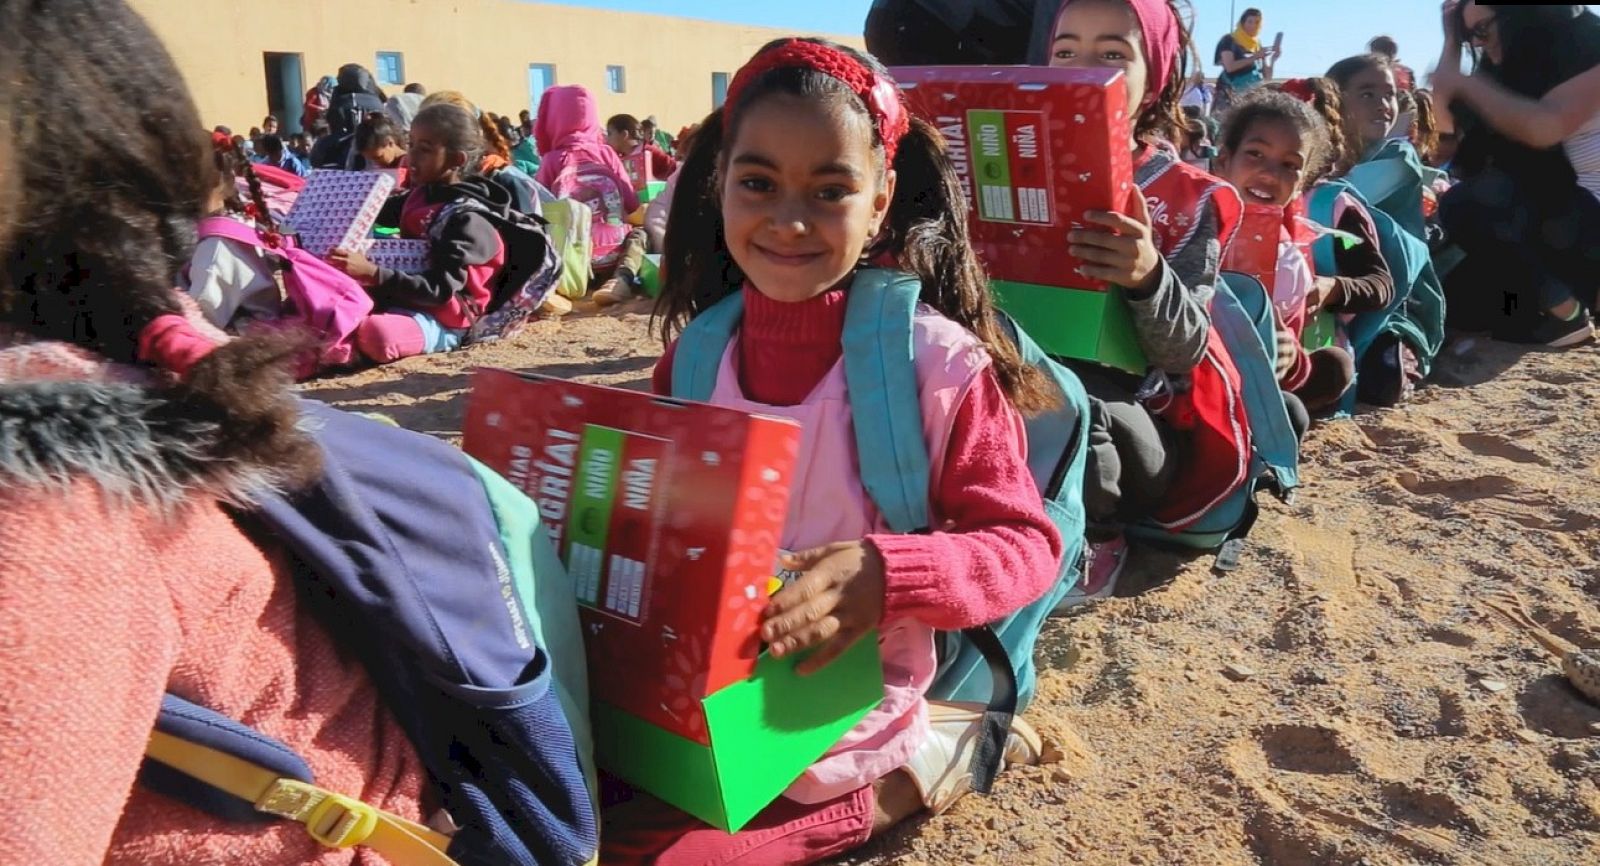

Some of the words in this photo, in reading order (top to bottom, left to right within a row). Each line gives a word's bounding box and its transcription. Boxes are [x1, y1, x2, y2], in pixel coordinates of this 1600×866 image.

[977, 124, 1001, 156] NIÑO
[1013, 125, 1038, 158] NIÑA
[582, 449, 613, 499] NIÑO
[622, 459, 658, 510] NIÑA
